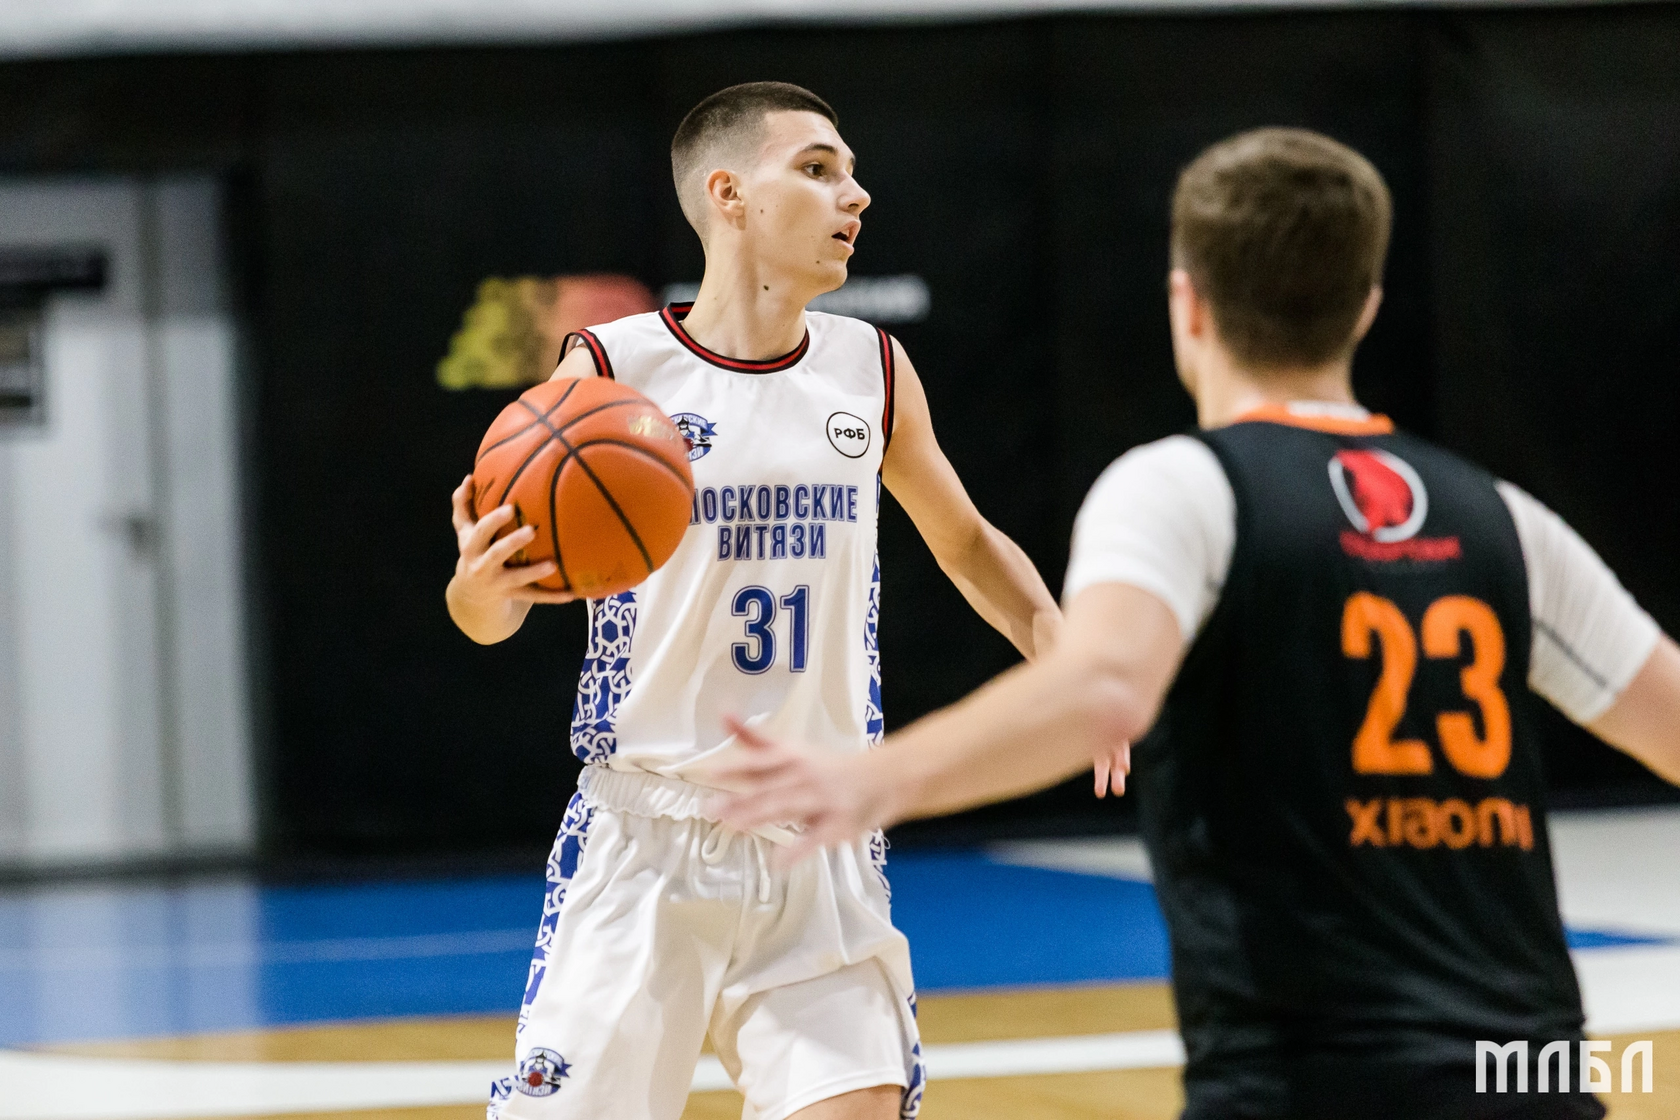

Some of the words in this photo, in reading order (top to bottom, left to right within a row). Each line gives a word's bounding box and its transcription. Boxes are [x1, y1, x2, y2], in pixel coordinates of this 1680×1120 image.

[834, 427, 866, 441] РФБ
[717, 523, 826, 560] ВИТЯЗИ
[731, 584, 810, 675] 31
[1341, 591, 1512, 779] 23
